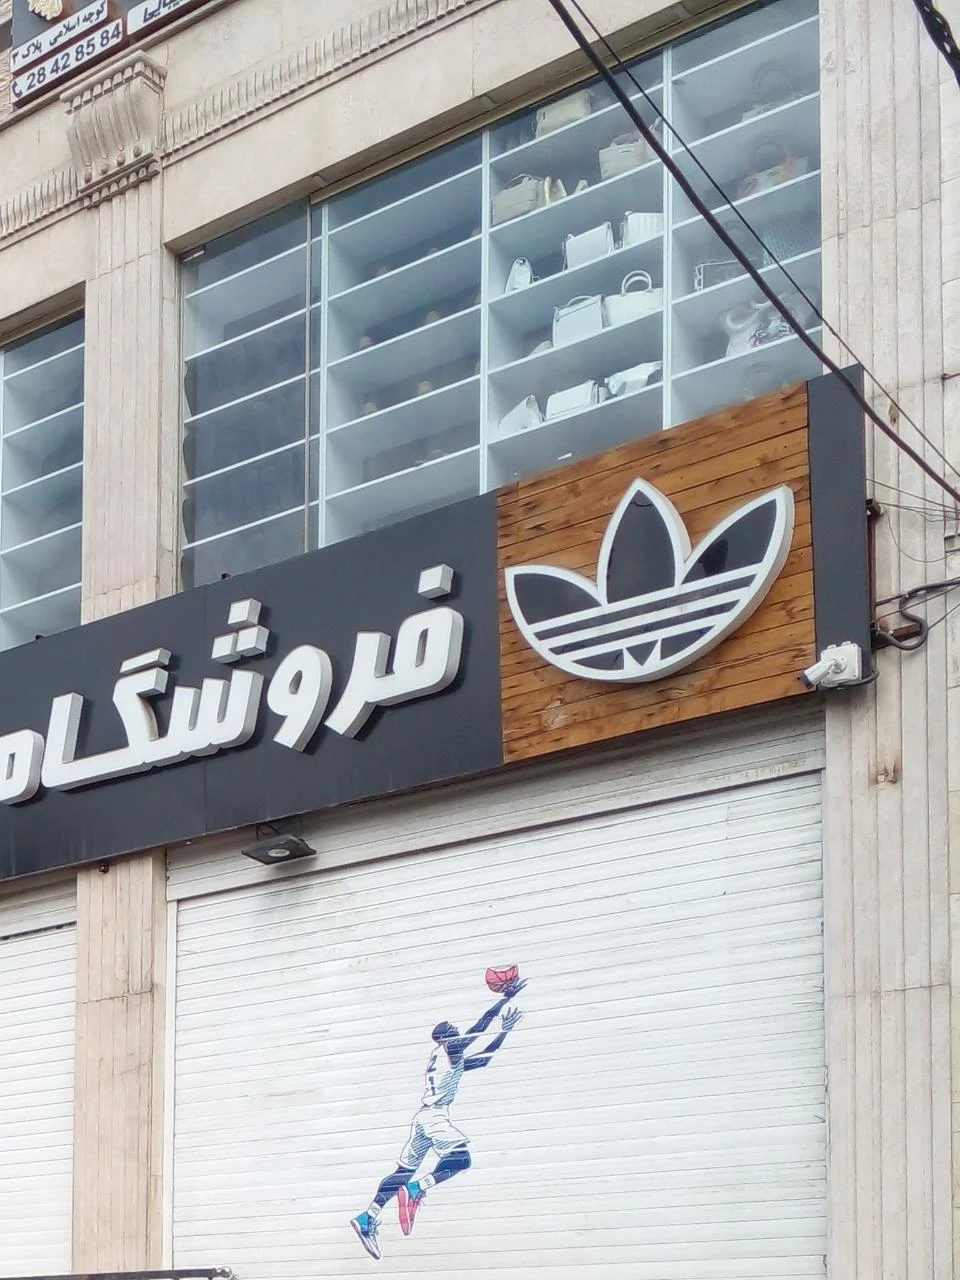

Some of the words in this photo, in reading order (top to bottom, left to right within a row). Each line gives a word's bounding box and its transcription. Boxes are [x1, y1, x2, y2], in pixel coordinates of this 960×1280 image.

[82, 1, 106, 23] کوچه
[49, 16, 80, 46] اسلامی
[22, 40, 42, 59] پلاک
[26, 66, 46, 91] 28
[50, 52, 71, 76] 42
[75, 37, 95, 62] 85
[100, 22, 121, 48] 84
